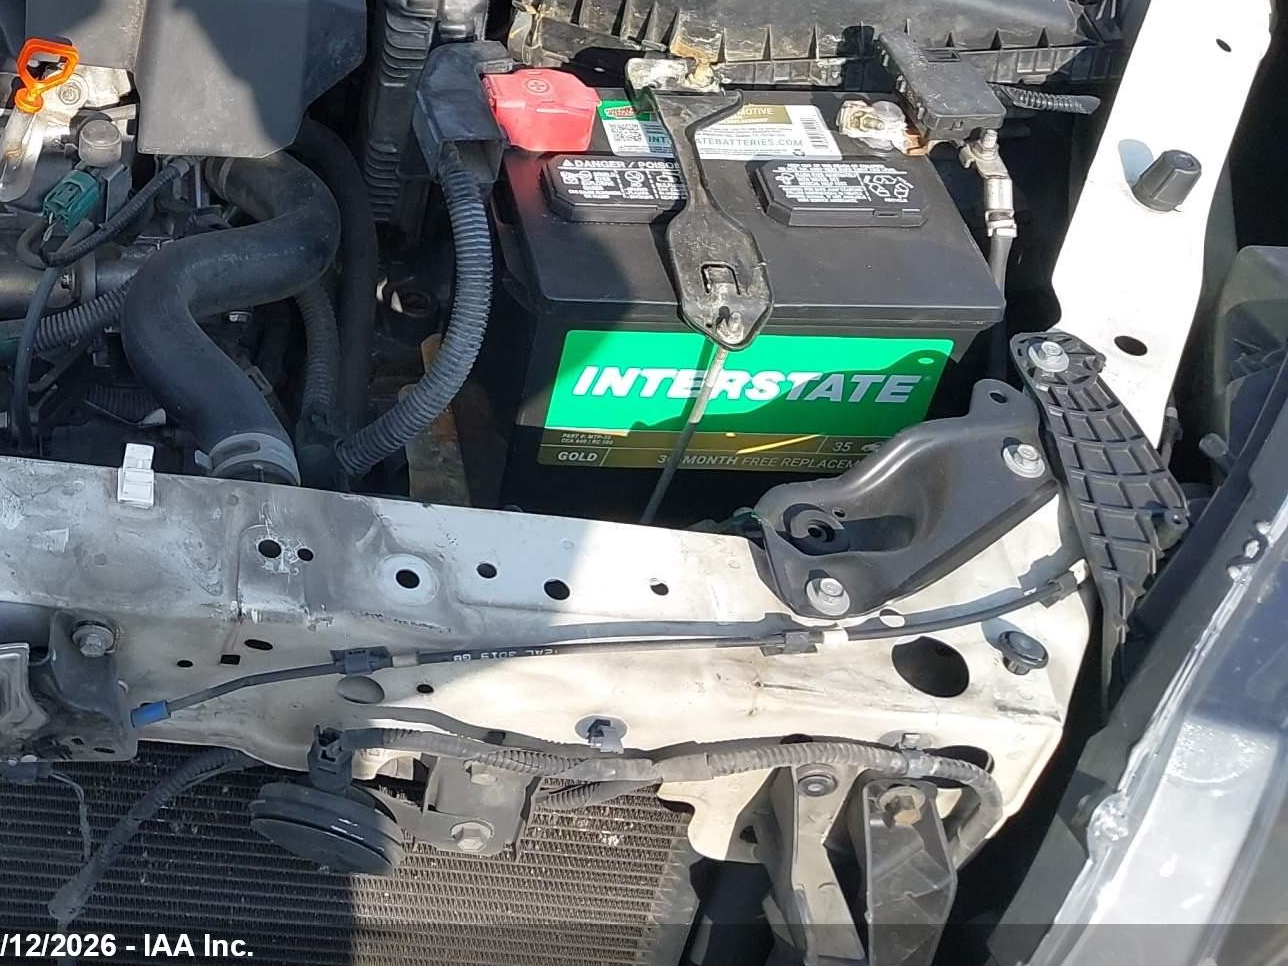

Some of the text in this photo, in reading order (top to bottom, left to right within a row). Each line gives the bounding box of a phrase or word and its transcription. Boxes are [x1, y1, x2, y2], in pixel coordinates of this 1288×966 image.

[574, 160, 625, 168] DANGER
[572, 366, 922, 404] INTERSTATE
[832, 441, 853, 452] 35
[557, 451, 598, 462] GOLD
[682, 455, 739, 465] MONTH
[741, 456, 778, 467] FREE
[780, 457, 860, 469] REPLACEM
